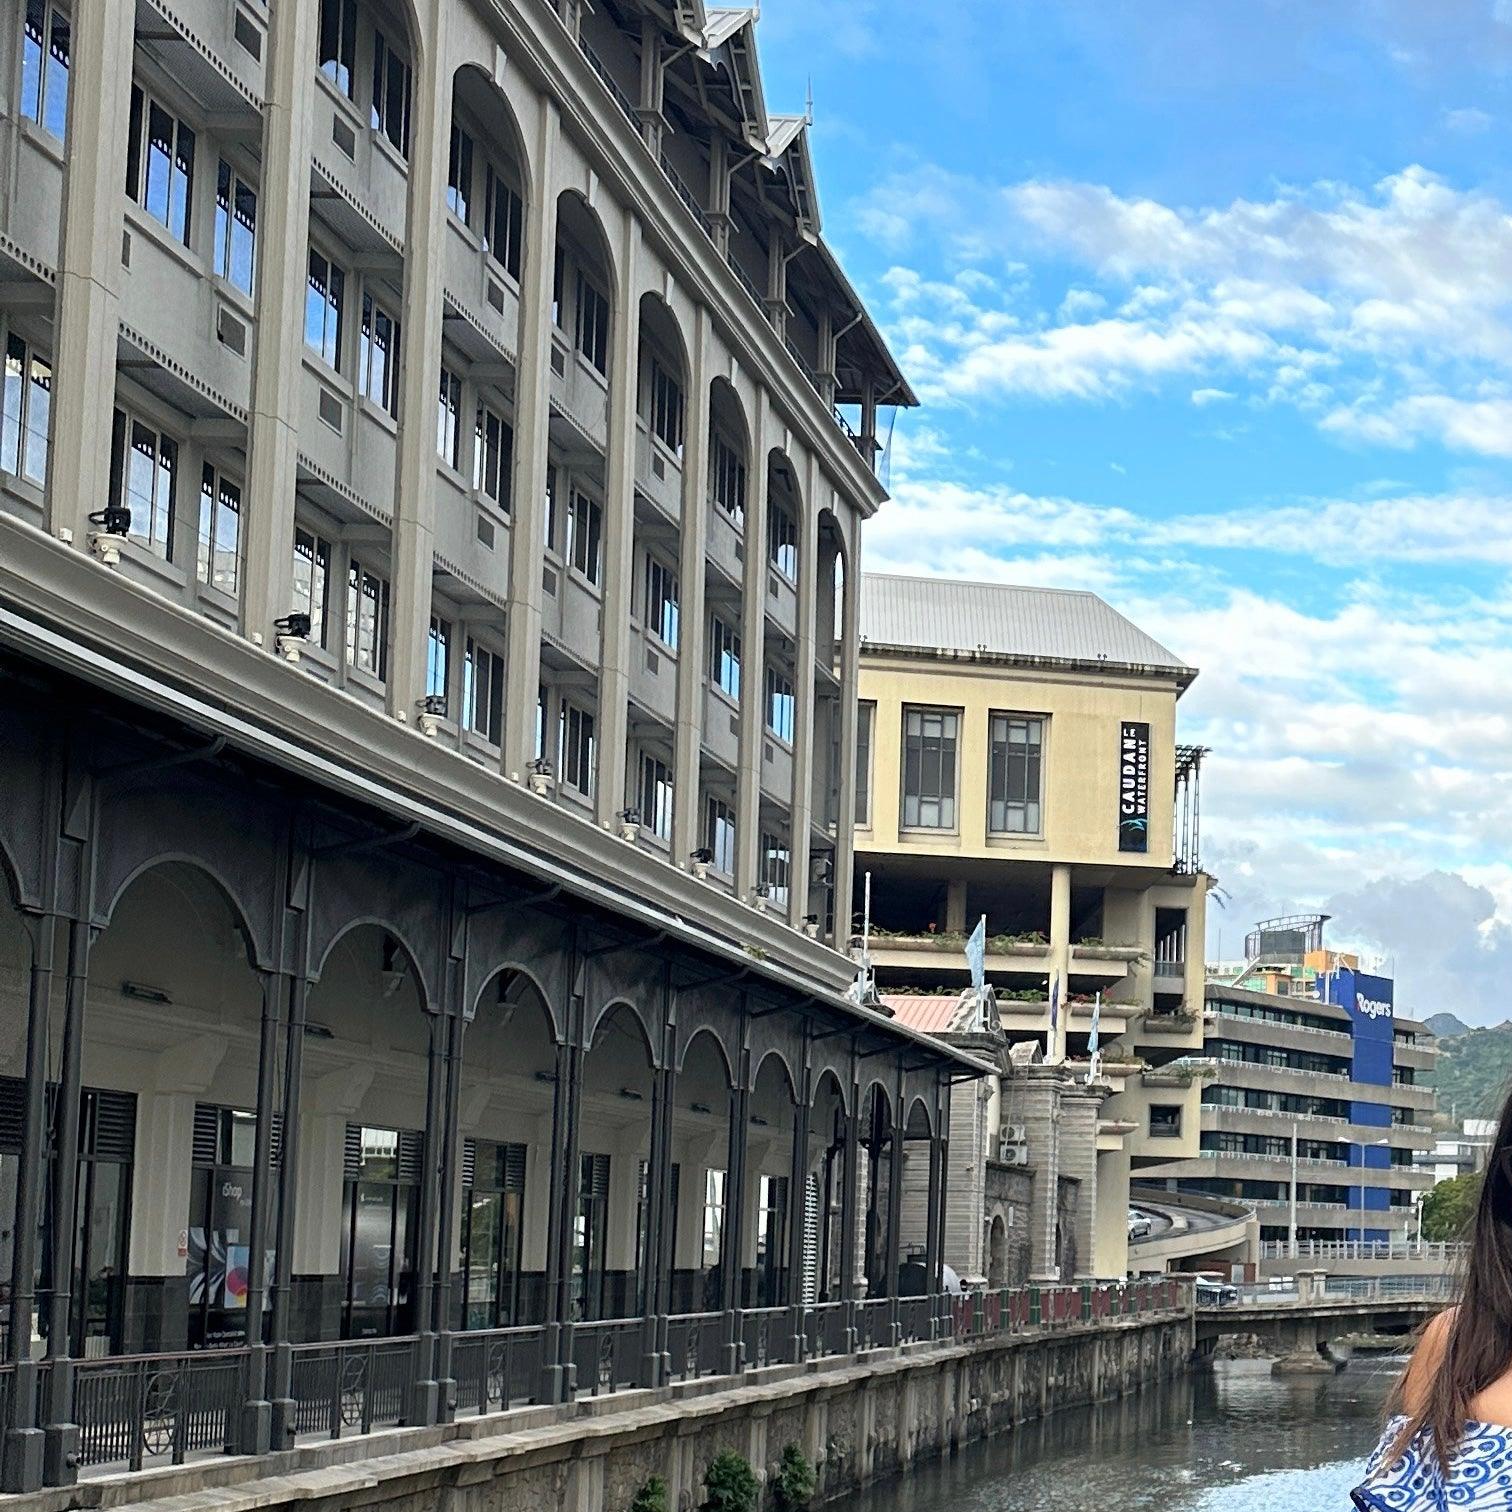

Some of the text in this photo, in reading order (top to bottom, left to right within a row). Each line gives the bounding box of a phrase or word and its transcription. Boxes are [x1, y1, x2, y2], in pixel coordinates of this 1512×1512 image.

[1123, 728, 1137, 737] LE
[1122, 739, 1137, 814] CAUDAN
[1137, 740, 1147, 814] WATERFRONT
[1356, 992, 1391, 1019] Rogers
